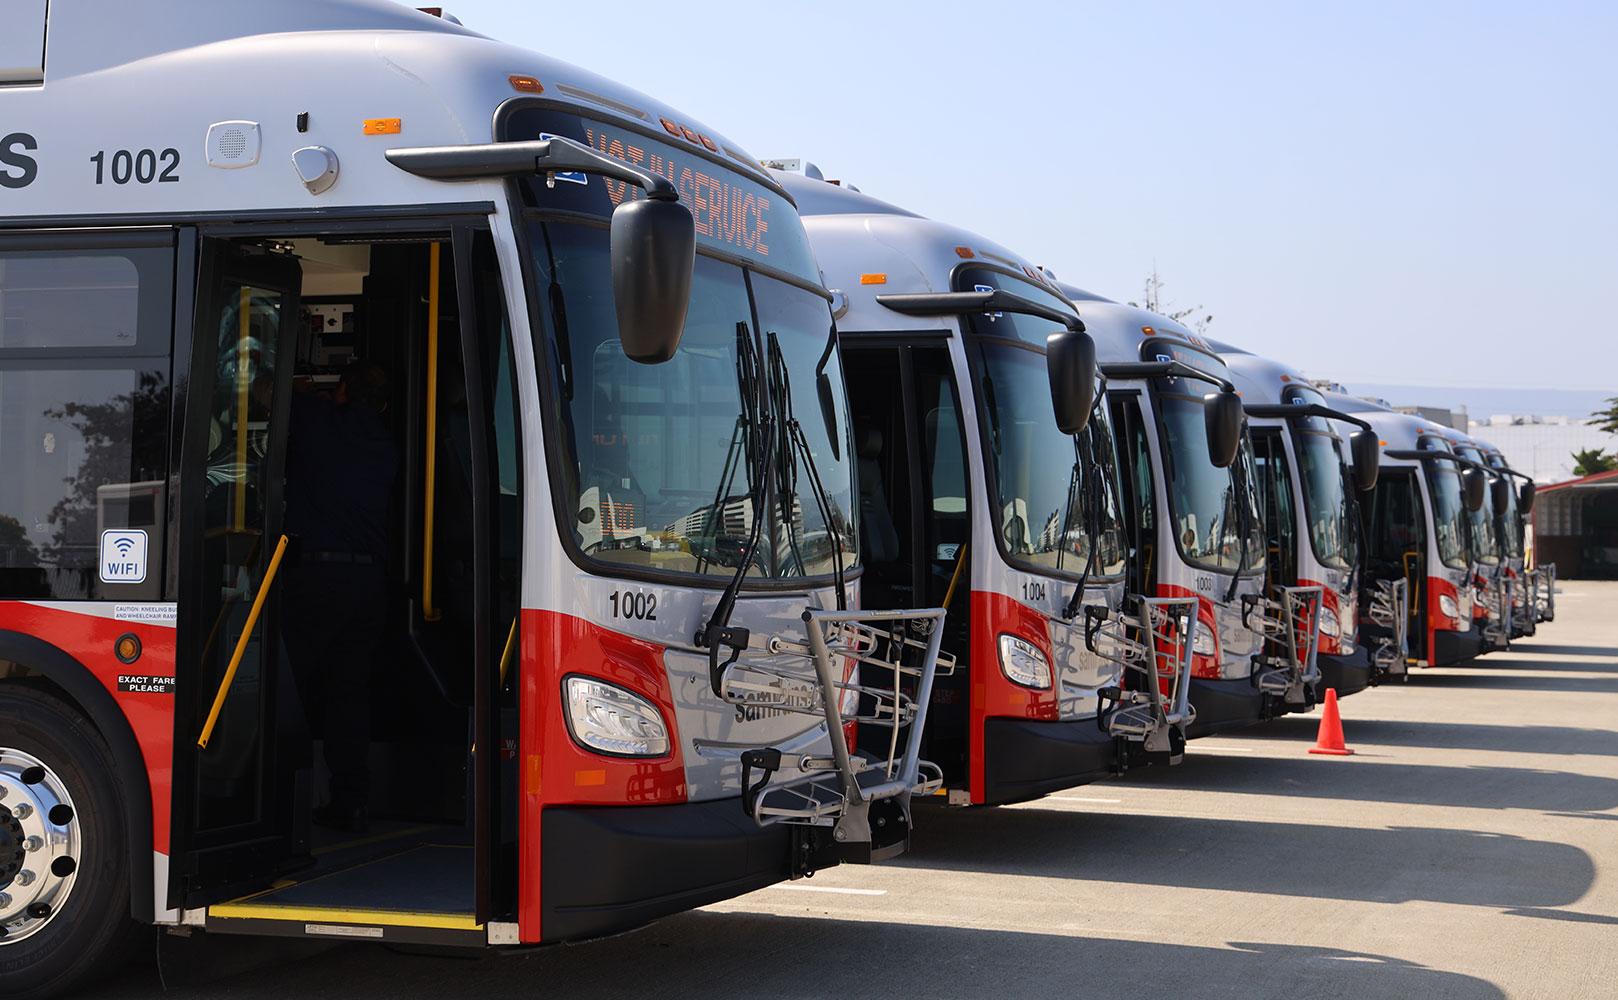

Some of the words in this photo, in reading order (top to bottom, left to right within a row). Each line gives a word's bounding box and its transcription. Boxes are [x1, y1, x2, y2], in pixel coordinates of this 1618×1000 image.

[90, 148, 180, 185] 1002
[679, 167, 769, 256] SERVICE
[108, 563, 138, 575] WIFI
[1022, 582, 1046, 601] 1004
[609, 590, 657, 621] 1002
[118, 675, 148, 684] EXACT
[152, 677, 175, 685] FARE
[129, 684, 165, 693] PLEASE
